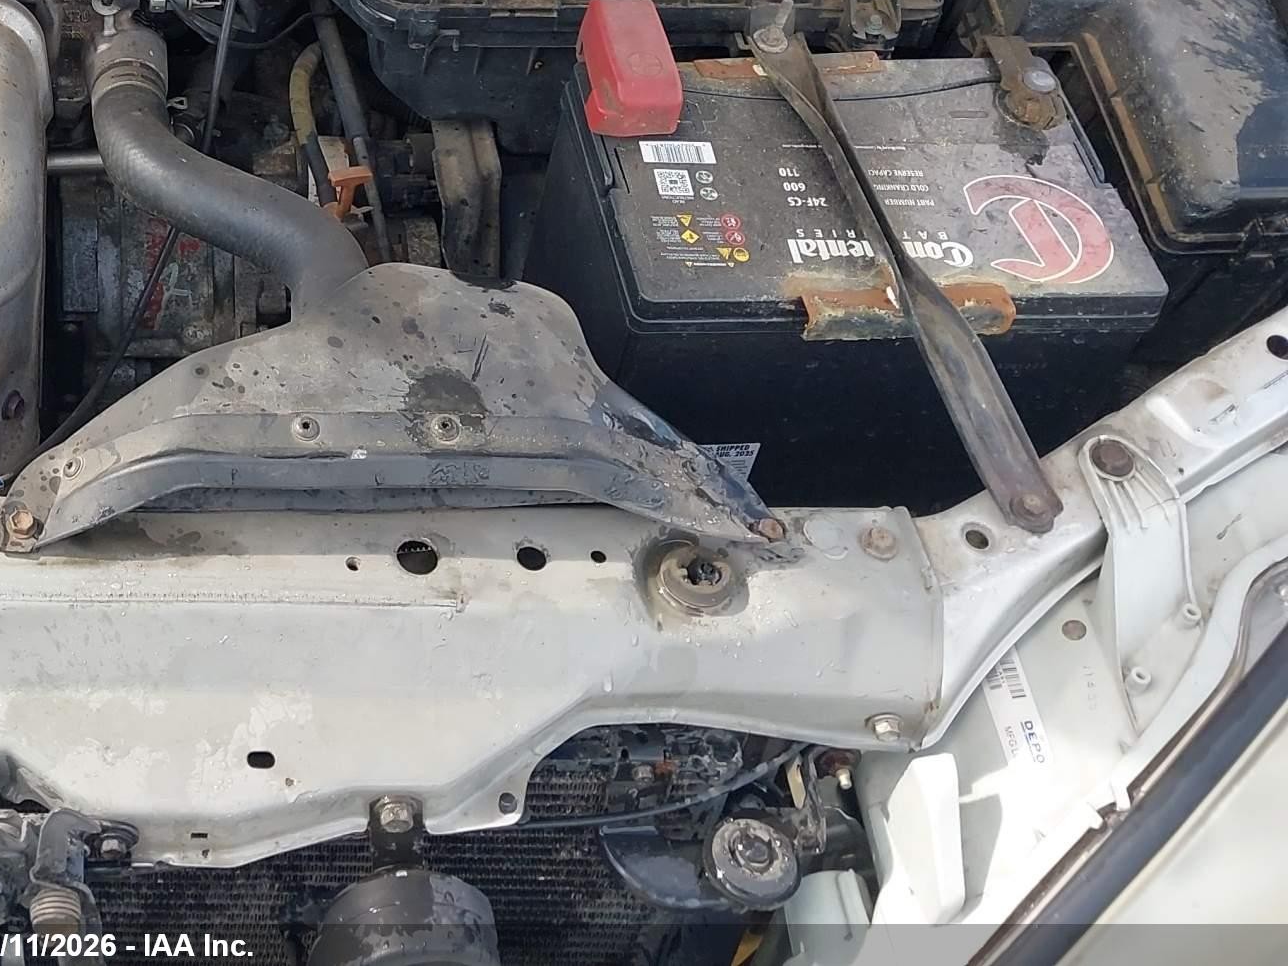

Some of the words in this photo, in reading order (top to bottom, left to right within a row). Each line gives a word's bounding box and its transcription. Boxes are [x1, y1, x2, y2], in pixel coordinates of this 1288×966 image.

[867, 169, 892, 177] CAPACI
[892, 169, 924, 177] RESERVE
[783, 181, 806, 192] 600
[910, 184, 929, 192] COLD
[787, 196, 827, 207] 24F-CS
[884, 198, 915, 206] NUMBER
[916, 198, 935, 206] PART
[795, 228, 949, 241] BATRIES
[734, 449, 754, 457] 2025
[1023, 719, 1045, 764] DEPO
